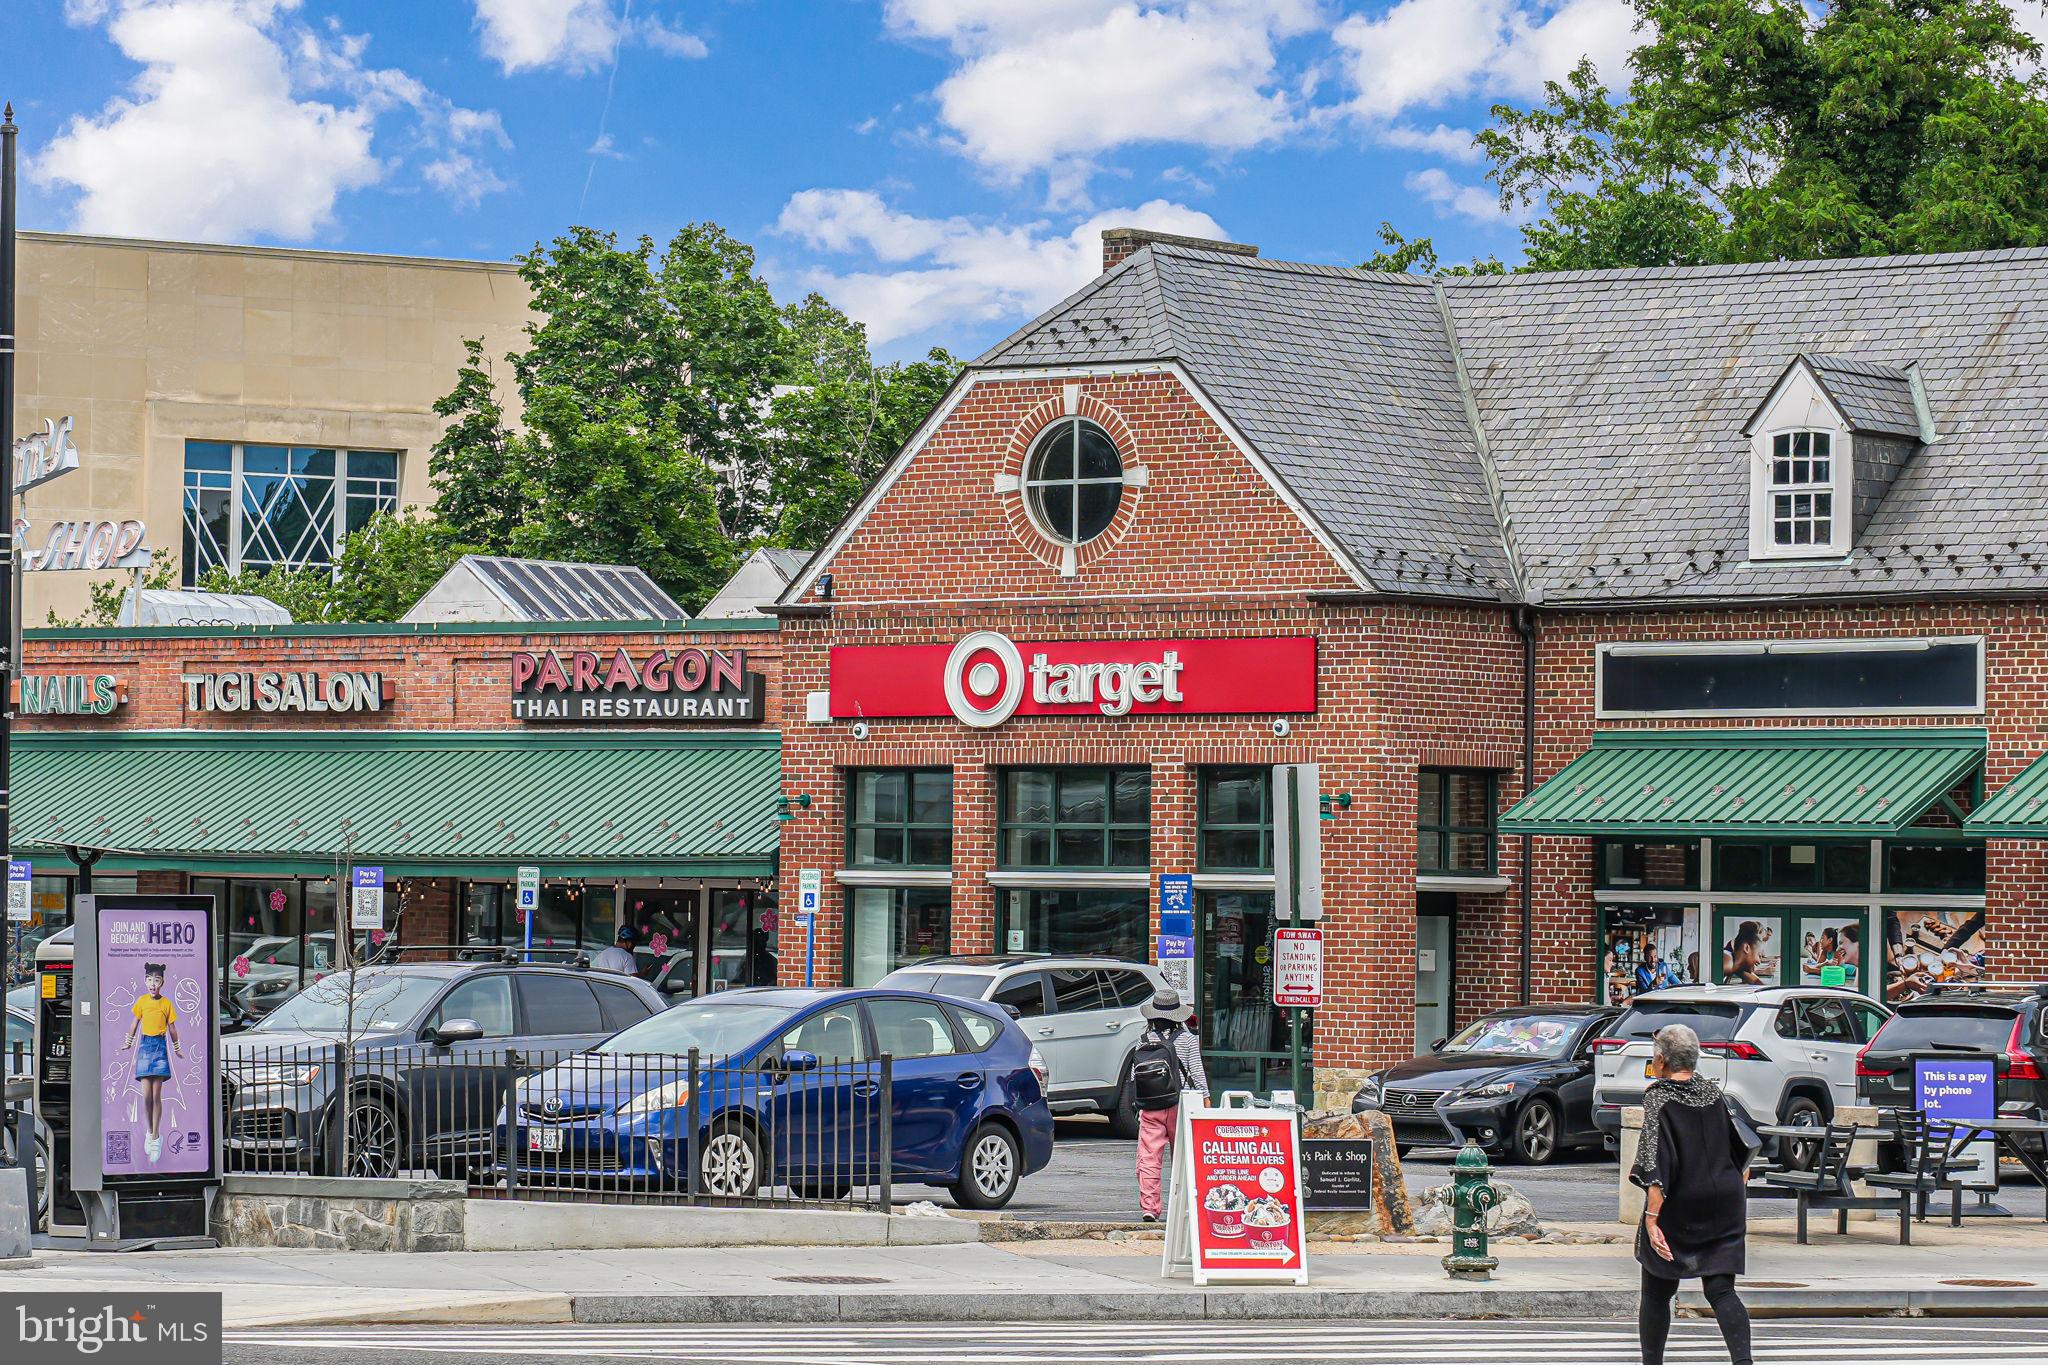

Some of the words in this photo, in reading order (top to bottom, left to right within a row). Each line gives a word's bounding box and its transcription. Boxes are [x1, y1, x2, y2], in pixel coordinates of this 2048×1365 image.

[32, 520, 145, 571] SHOP
[512, 647, 745, 693] PARAGON
[1028, 651, 1184, 717] target
[19, 674, 117, 715] NAILS
[181, 672, 253, 712] TIGI
[256, 672, 383, 712] SALON
[513, 698, 569, 717] THAI
[581, 698, 750, 717] RESTAURANT
[110, 922, 128, 933] JOIN
[129, 922, 146, 932] AND
[148, 922, 195, 944] HERO
[111, 933, 139, 944] BECOME
[140, 933, 146, 943] A
[1282, 953, 1316, 961] STANDING
[1924, 1072, 1945, 1081] This
[1948, 1072, 1957, 1081] is
[1968, 1074, 1987, 1083] pay
[1924, 1086, 1936, 1096] by
[1940, 1086, 1972, 1096] phone
[1924, 1099, 1941, 1108] lot.
[1202, 1141, 1257, 1154] CALLING
[1260, 1141, 1284, 1154] ALL
[1204, 1155, 1218, 1164] ICE
[1220, 1155, 1250, 1164] CREAM
[1252, 1155, 1284, 1164] LOVERS
[1315, 1151, 1332, 1161] Park
[1336, 1152, 1342, 1161] &
[1346, 1151, 1367, 1163] Shop
